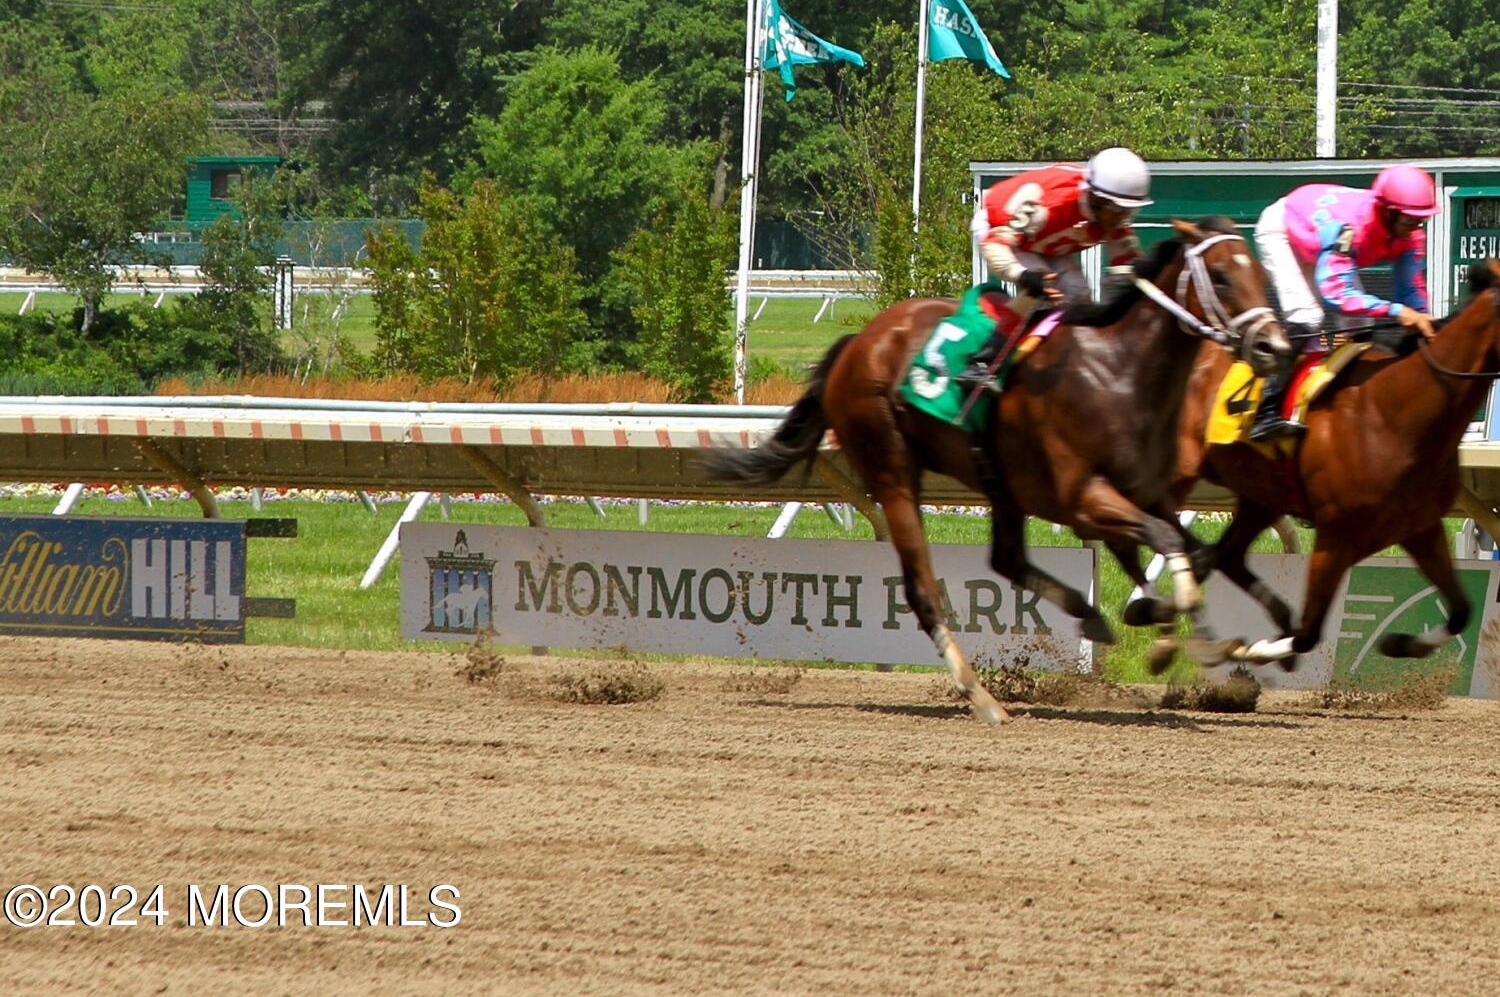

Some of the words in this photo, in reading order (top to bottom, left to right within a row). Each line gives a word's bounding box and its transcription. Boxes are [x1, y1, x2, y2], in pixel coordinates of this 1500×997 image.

[909, 321, 968, 399] 5
[0, 530, 129, 617] illiam
[130, 538, 241, 621] HILL
[514, 559, 863, 629] MONMOUTH
